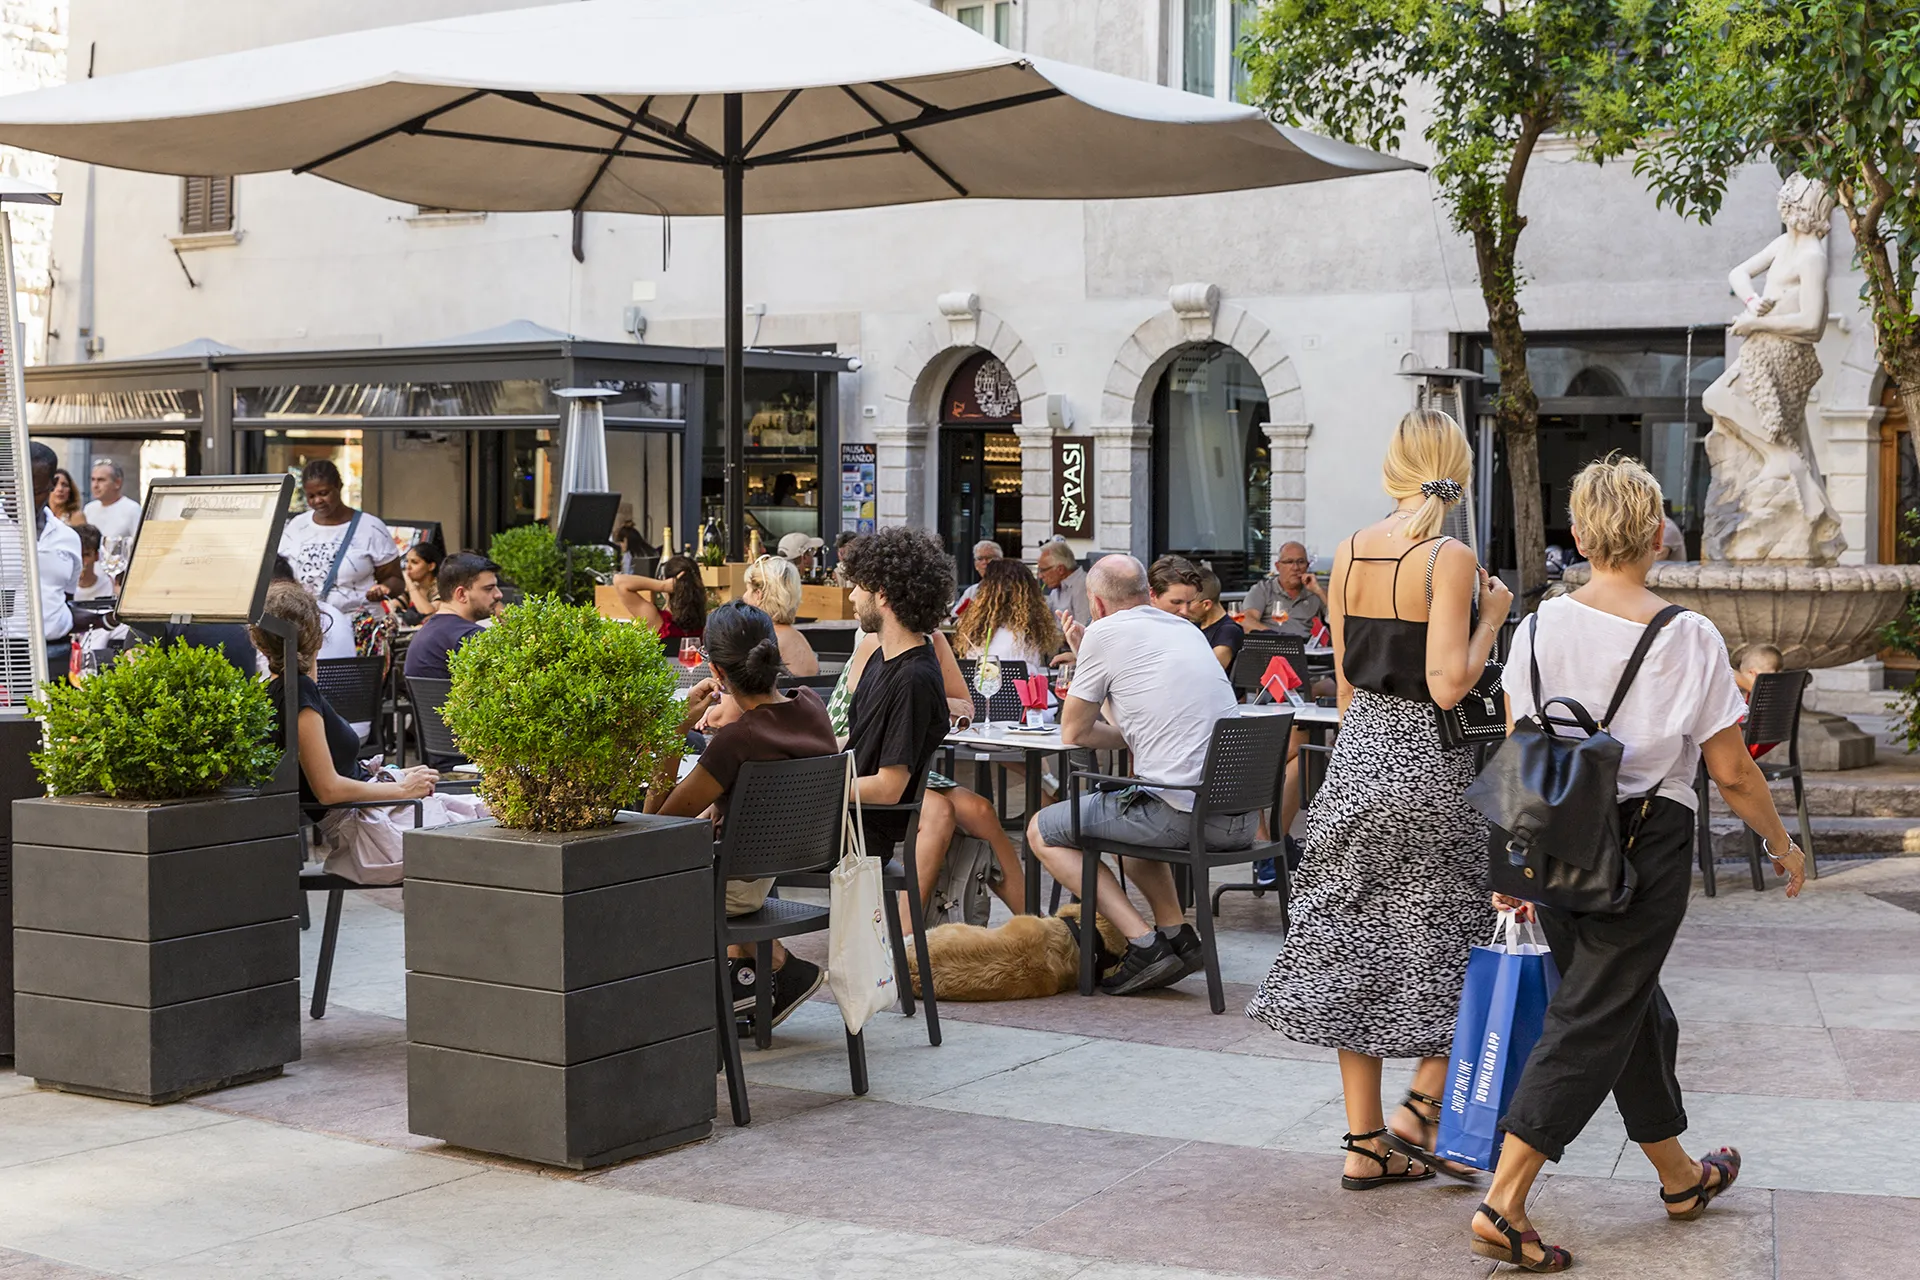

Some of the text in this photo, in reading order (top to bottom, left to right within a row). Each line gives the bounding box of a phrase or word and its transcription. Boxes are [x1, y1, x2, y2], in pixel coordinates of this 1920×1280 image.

[842, 445, 865, 453] PAUSA
[186, 495, 218, 509] MASO
[1063, 443, 1081, 527] BAR PASI
[1451, 1059, 1473, 1114] SHOP ONLINE
[1475, 1032, 1500, 1103] DOWNLOAD APP
